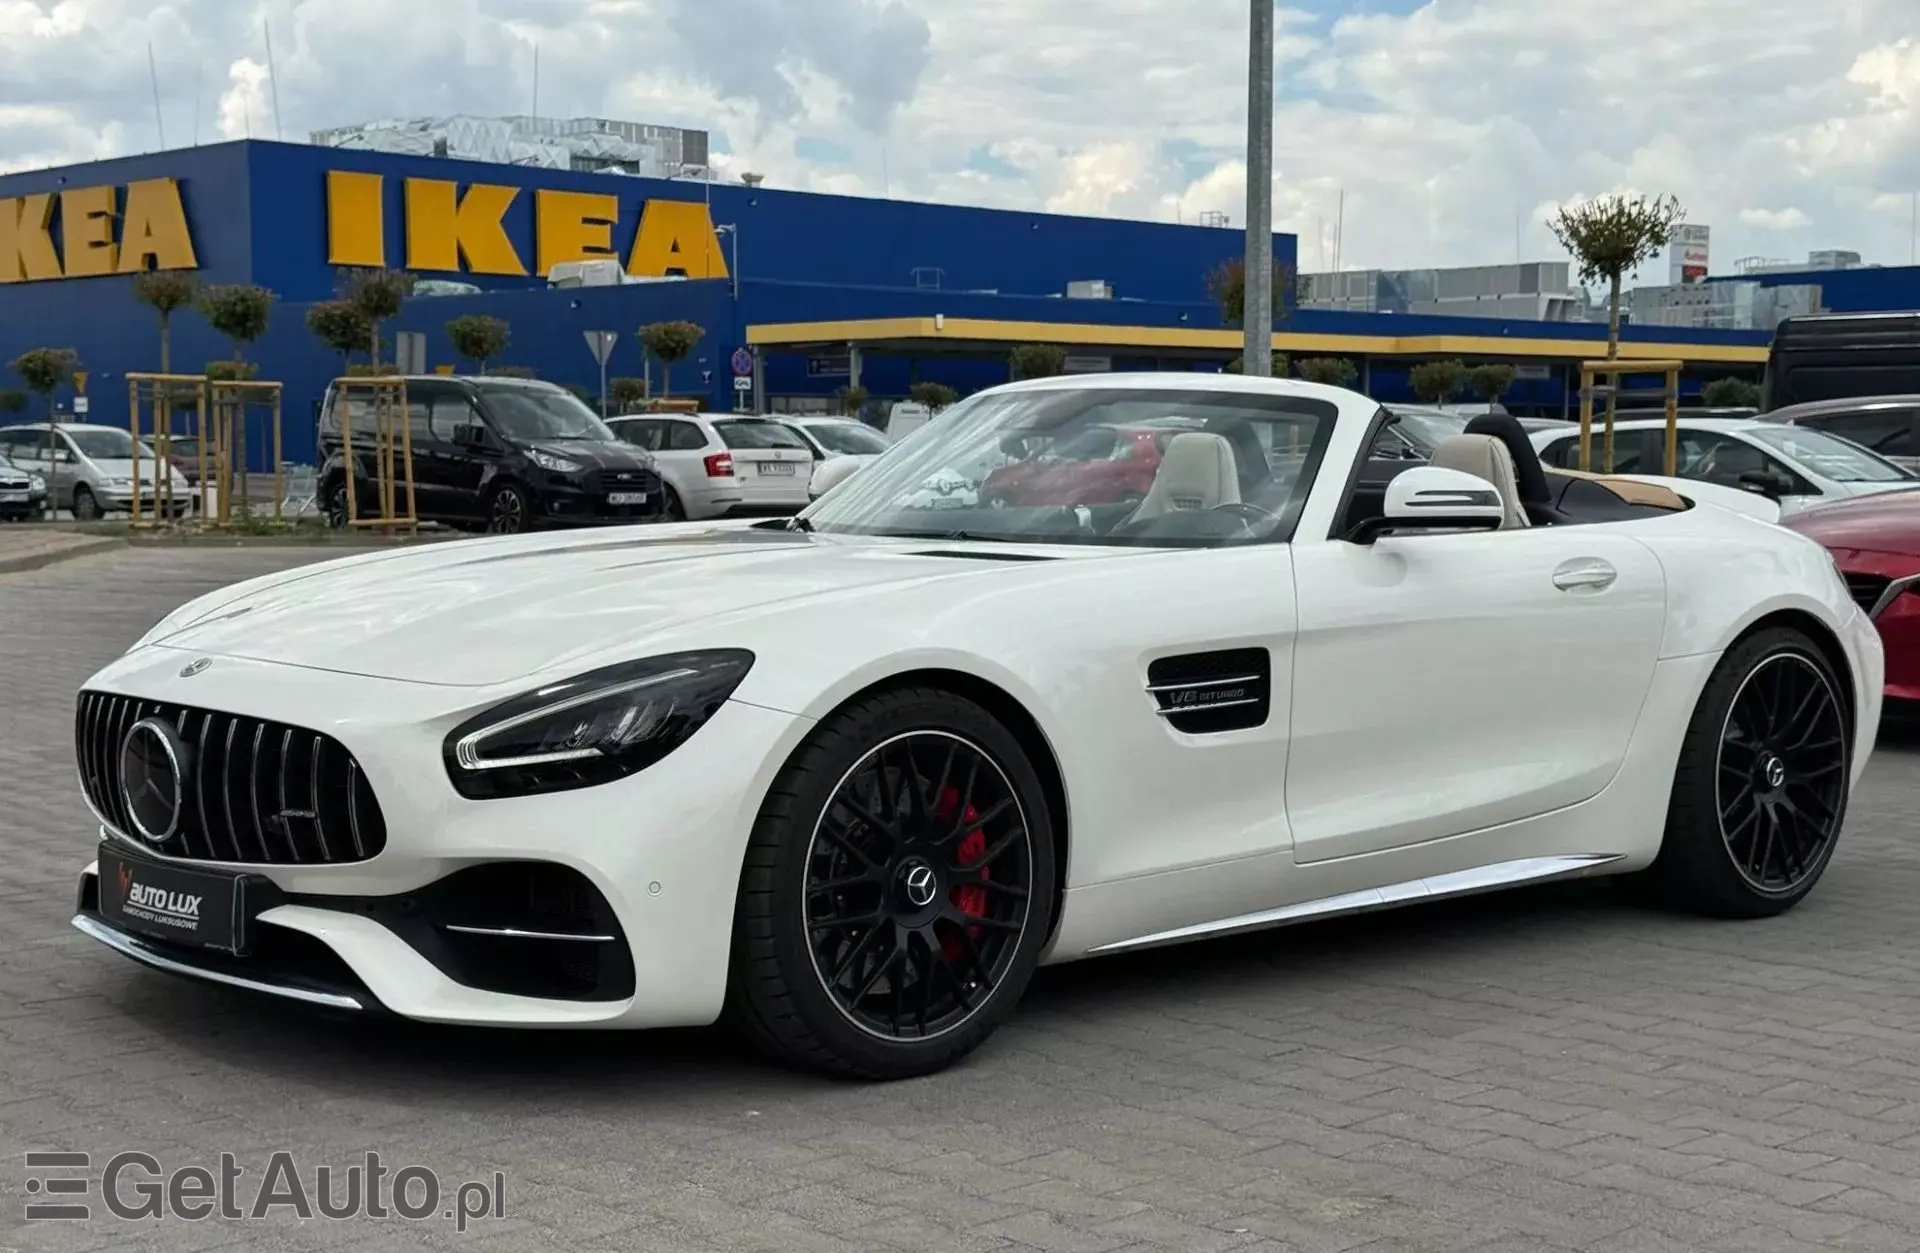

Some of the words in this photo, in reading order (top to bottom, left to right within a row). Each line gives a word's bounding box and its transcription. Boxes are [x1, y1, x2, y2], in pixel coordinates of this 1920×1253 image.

[327, 170, 729, 278] IKEA
[168, 892, 202, 915] LUX
[123, 905, 154, 920] SAMOCHODY
[154, 915, 198, 930] LUKSUSOWE
